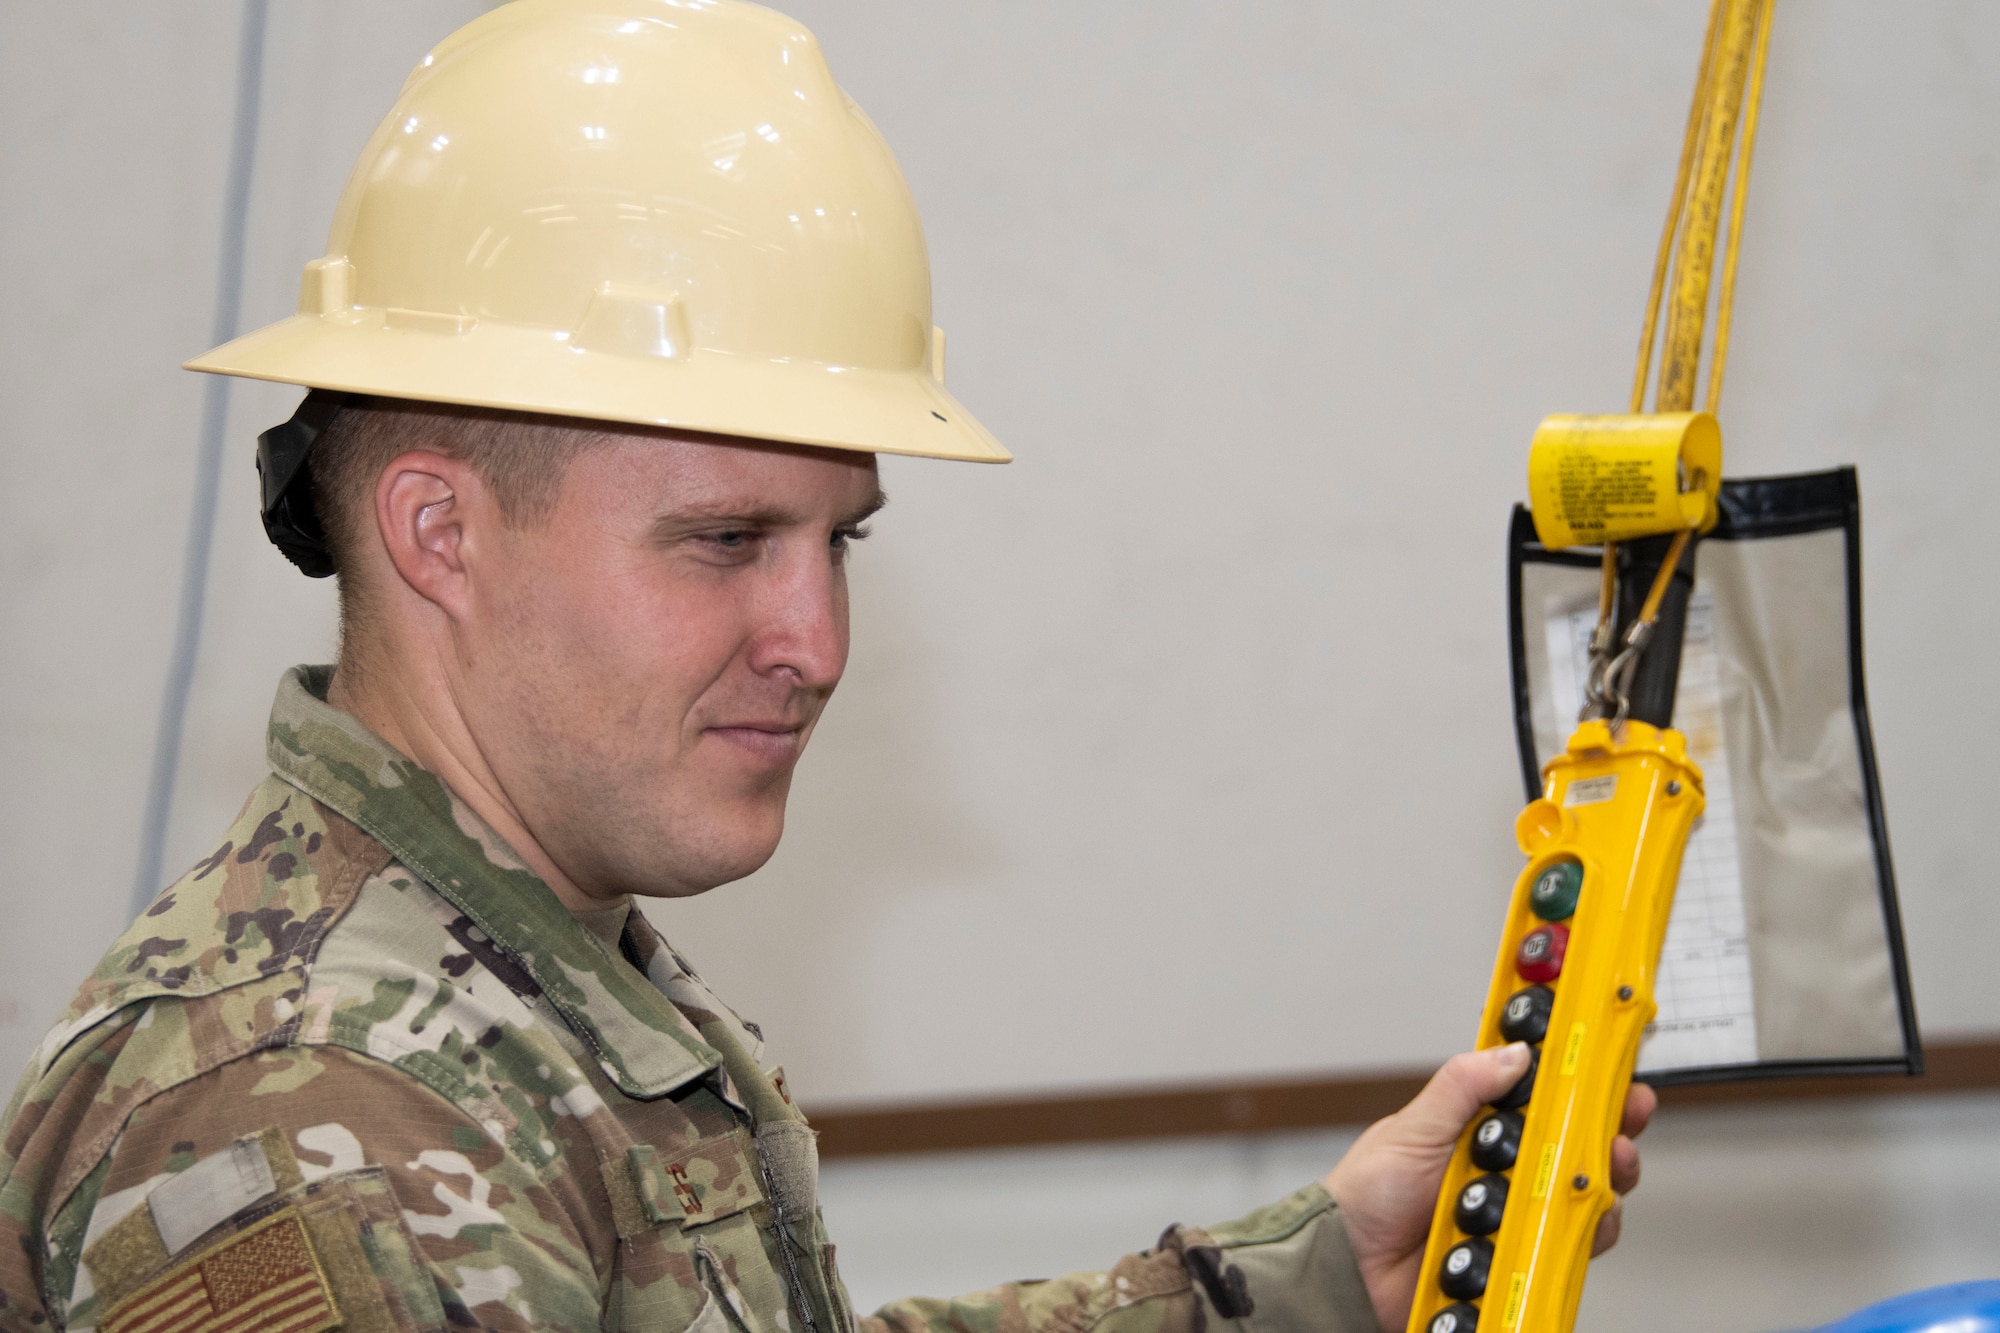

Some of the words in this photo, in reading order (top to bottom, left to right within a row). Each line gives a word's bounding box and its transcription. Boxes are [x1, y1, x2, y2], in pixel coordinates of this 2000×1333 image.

[1543, 875, 1561, 891] ON
[1528, 938, 1548, 955] OFF
[1511, 999, 1531, 1016] UP
[1483, 1124, 1496, 1142] E
[1465, 1188, 1485, 1203] W
[1452, 1249, 1467, 1270] S
